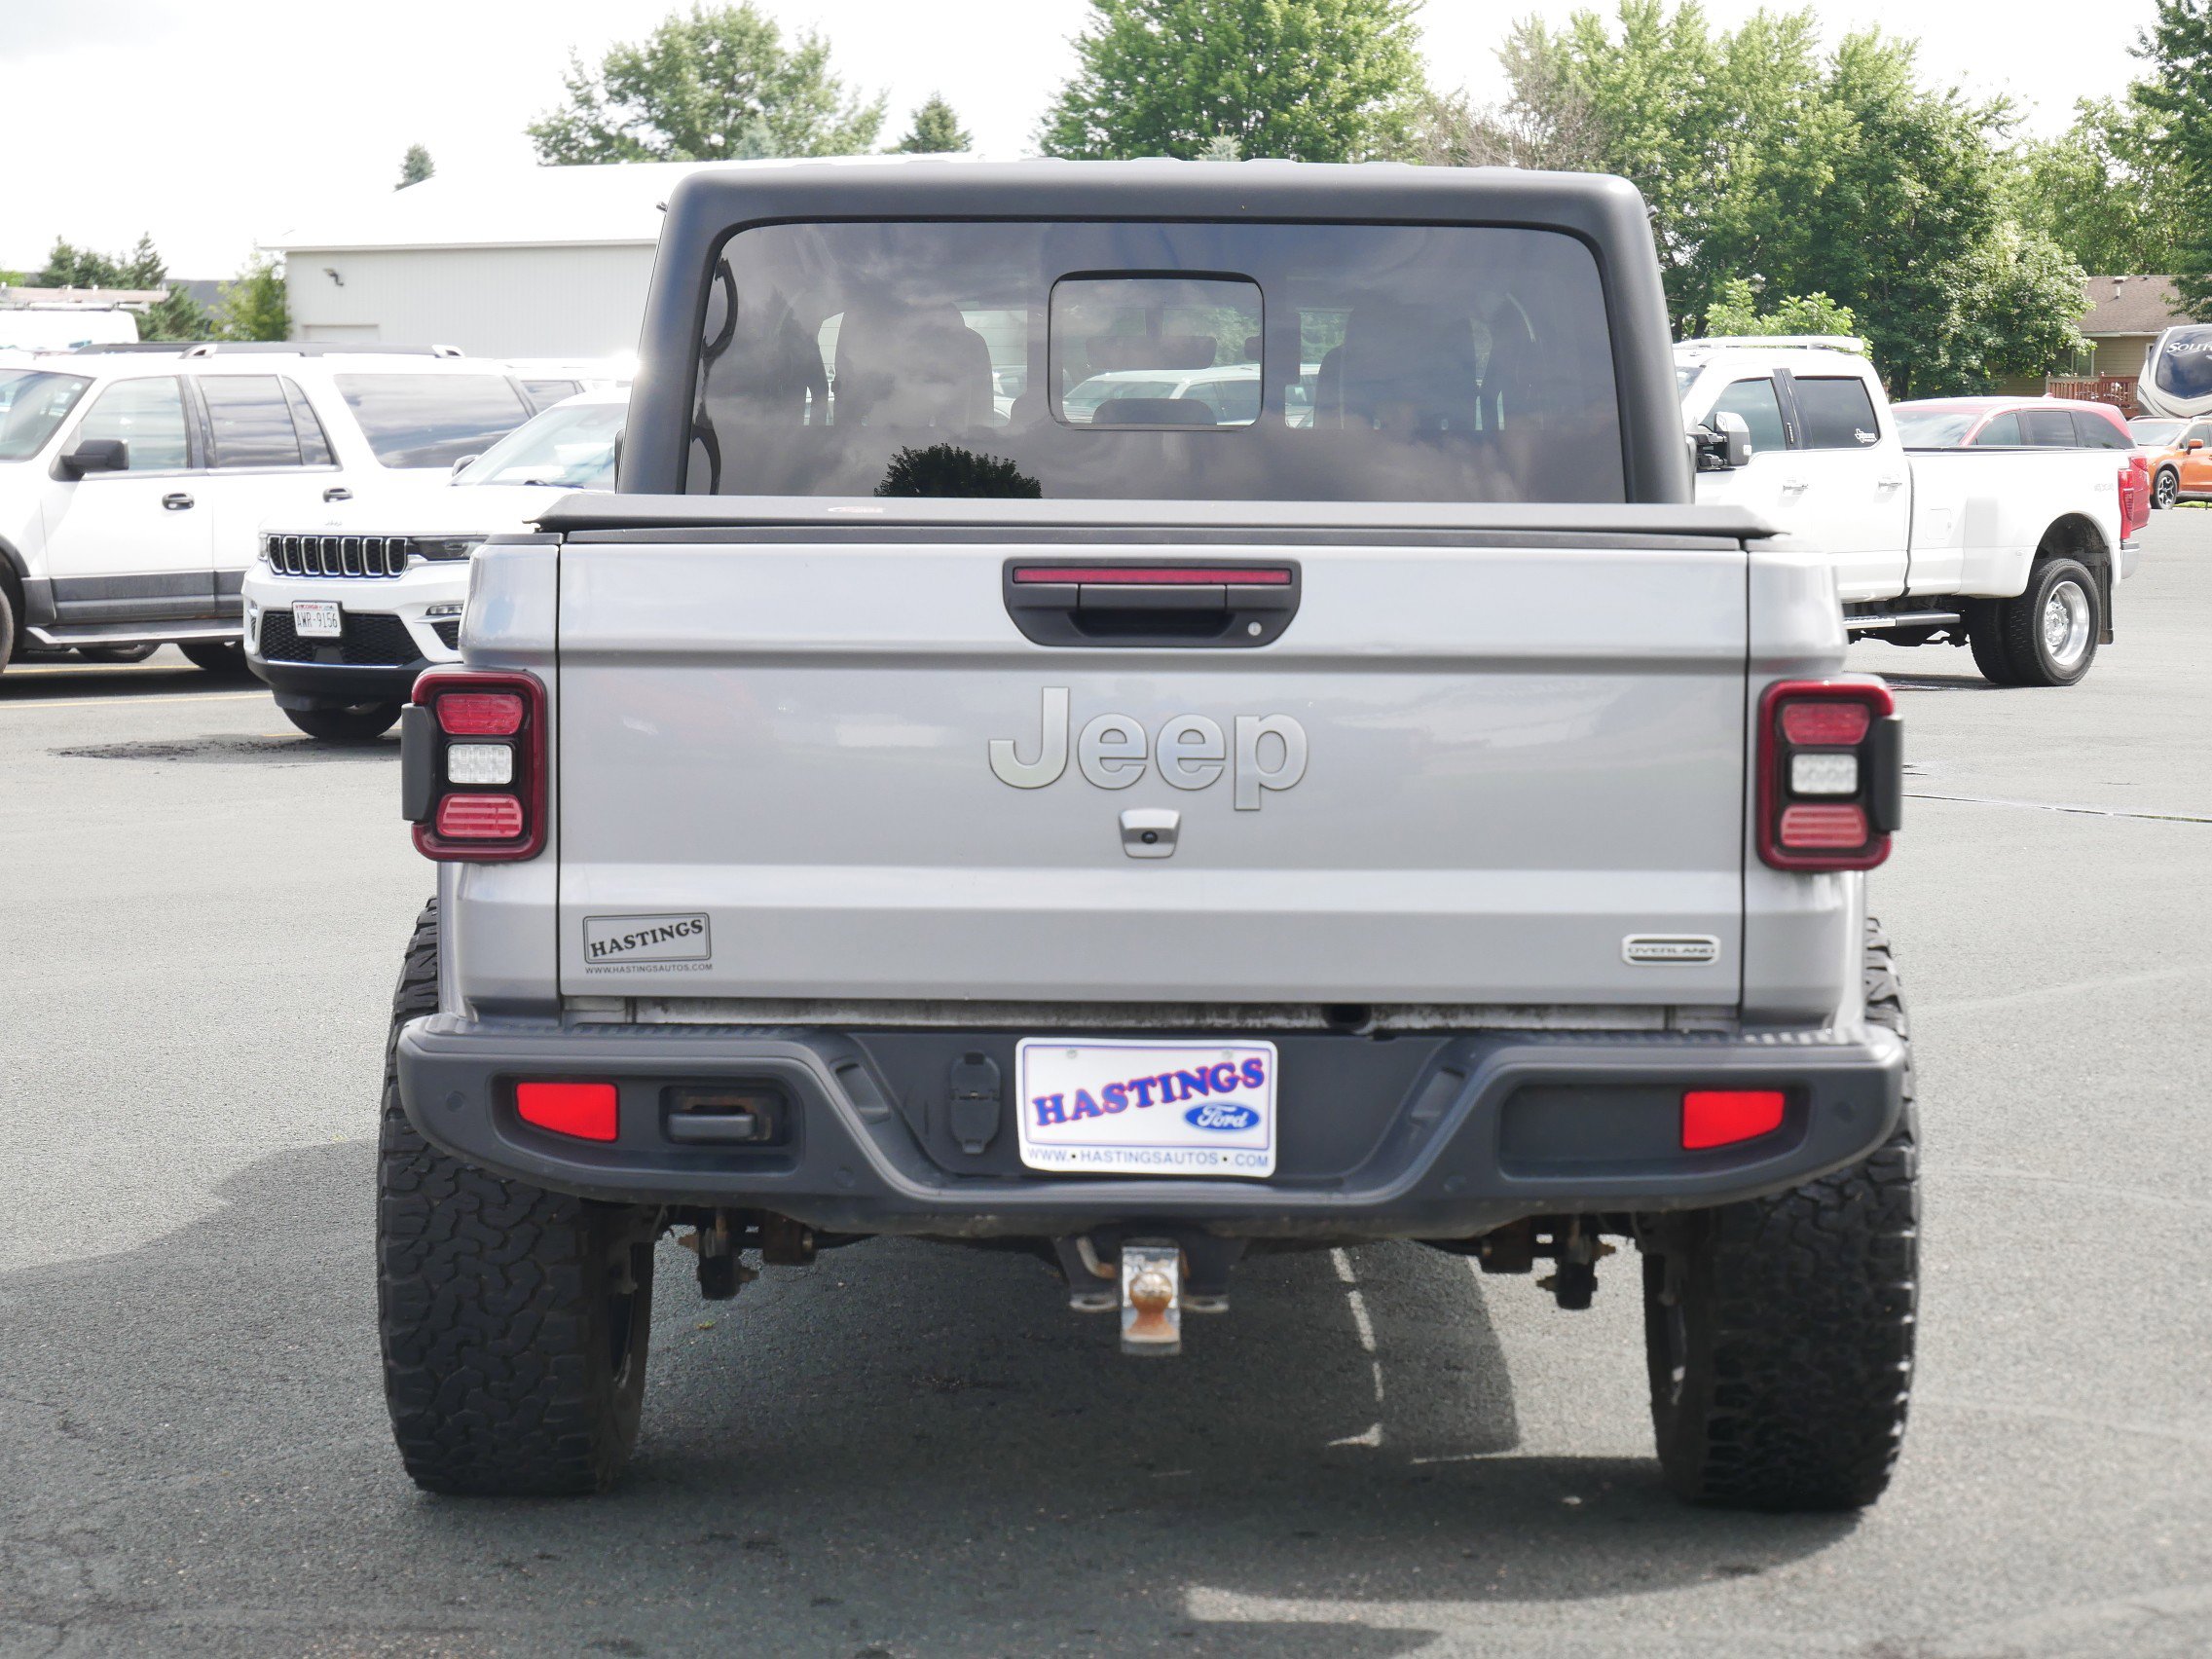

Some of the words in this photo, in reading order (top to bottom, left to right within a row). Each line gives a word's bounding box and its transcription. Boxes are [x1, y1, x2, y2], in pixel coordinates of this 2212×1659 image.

[297, 611, 338, 628] AWR-9156
[989, 686, 1308, 810] Jeep
[590, 919, 704, 957] HASTINGS
[585, 964, 713, 975] WWW.HASTINGSAUTOS.COM
[1032, 1057, 1265, 1126] HASTINGS
[1197, 1105, 1248, 1128] Ford
